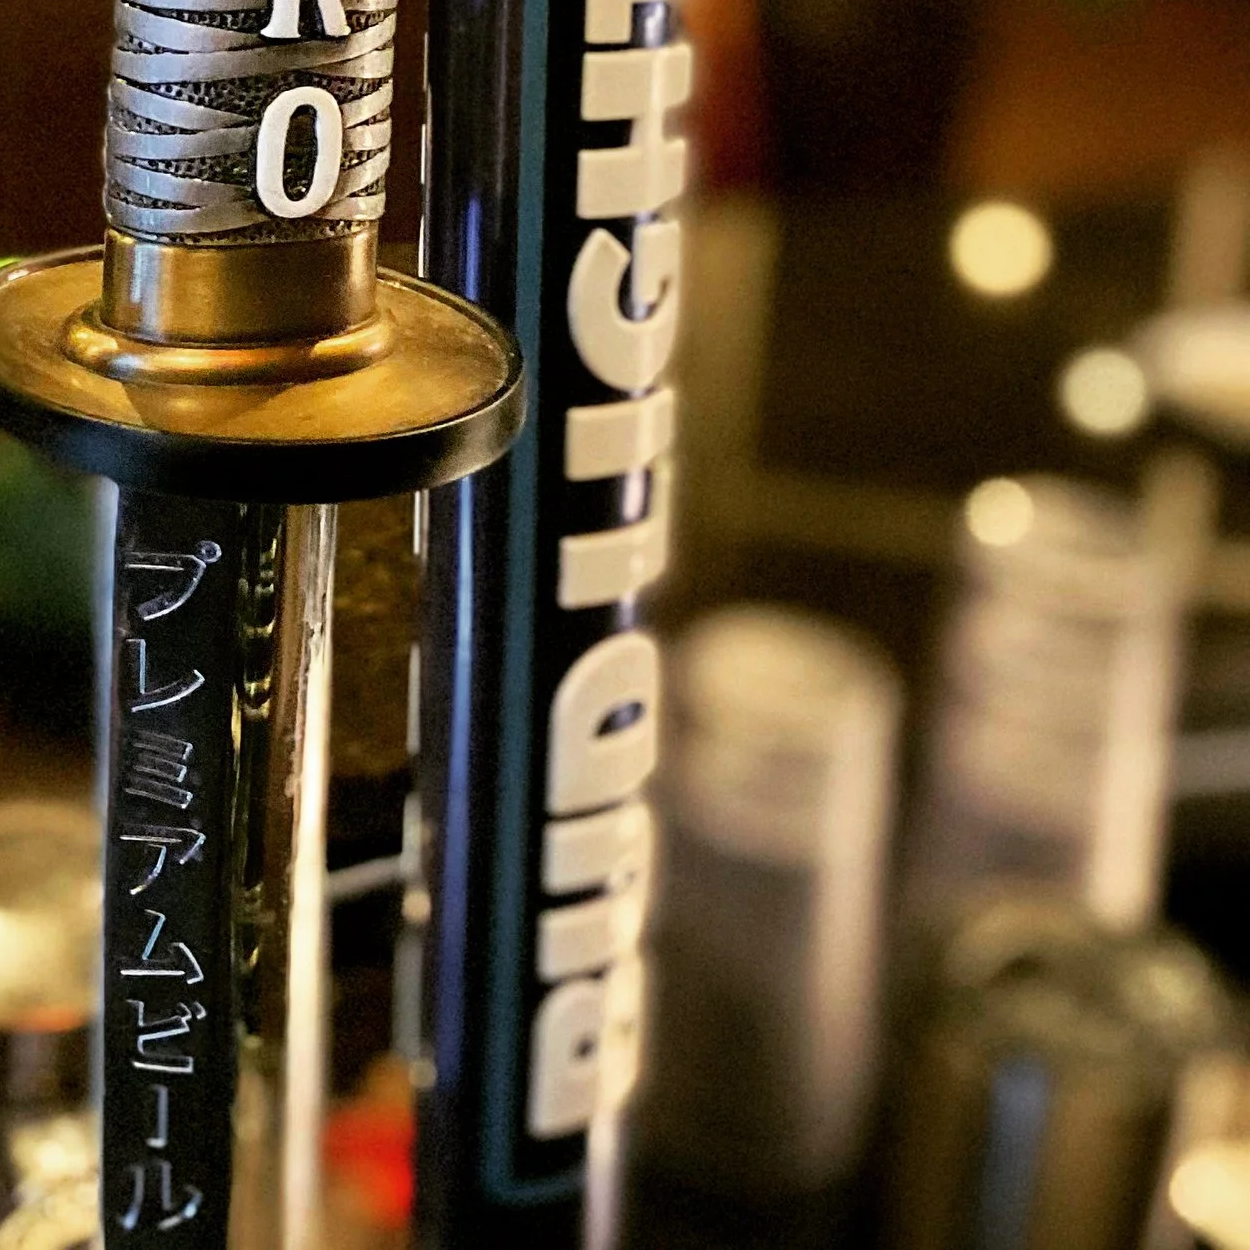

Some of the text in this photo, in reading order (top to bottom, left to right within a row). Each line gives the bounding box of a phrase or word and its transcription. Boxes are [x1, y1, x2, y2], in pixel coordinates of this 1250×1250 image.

[119, 538, 222, 1230] プレミアムビール
